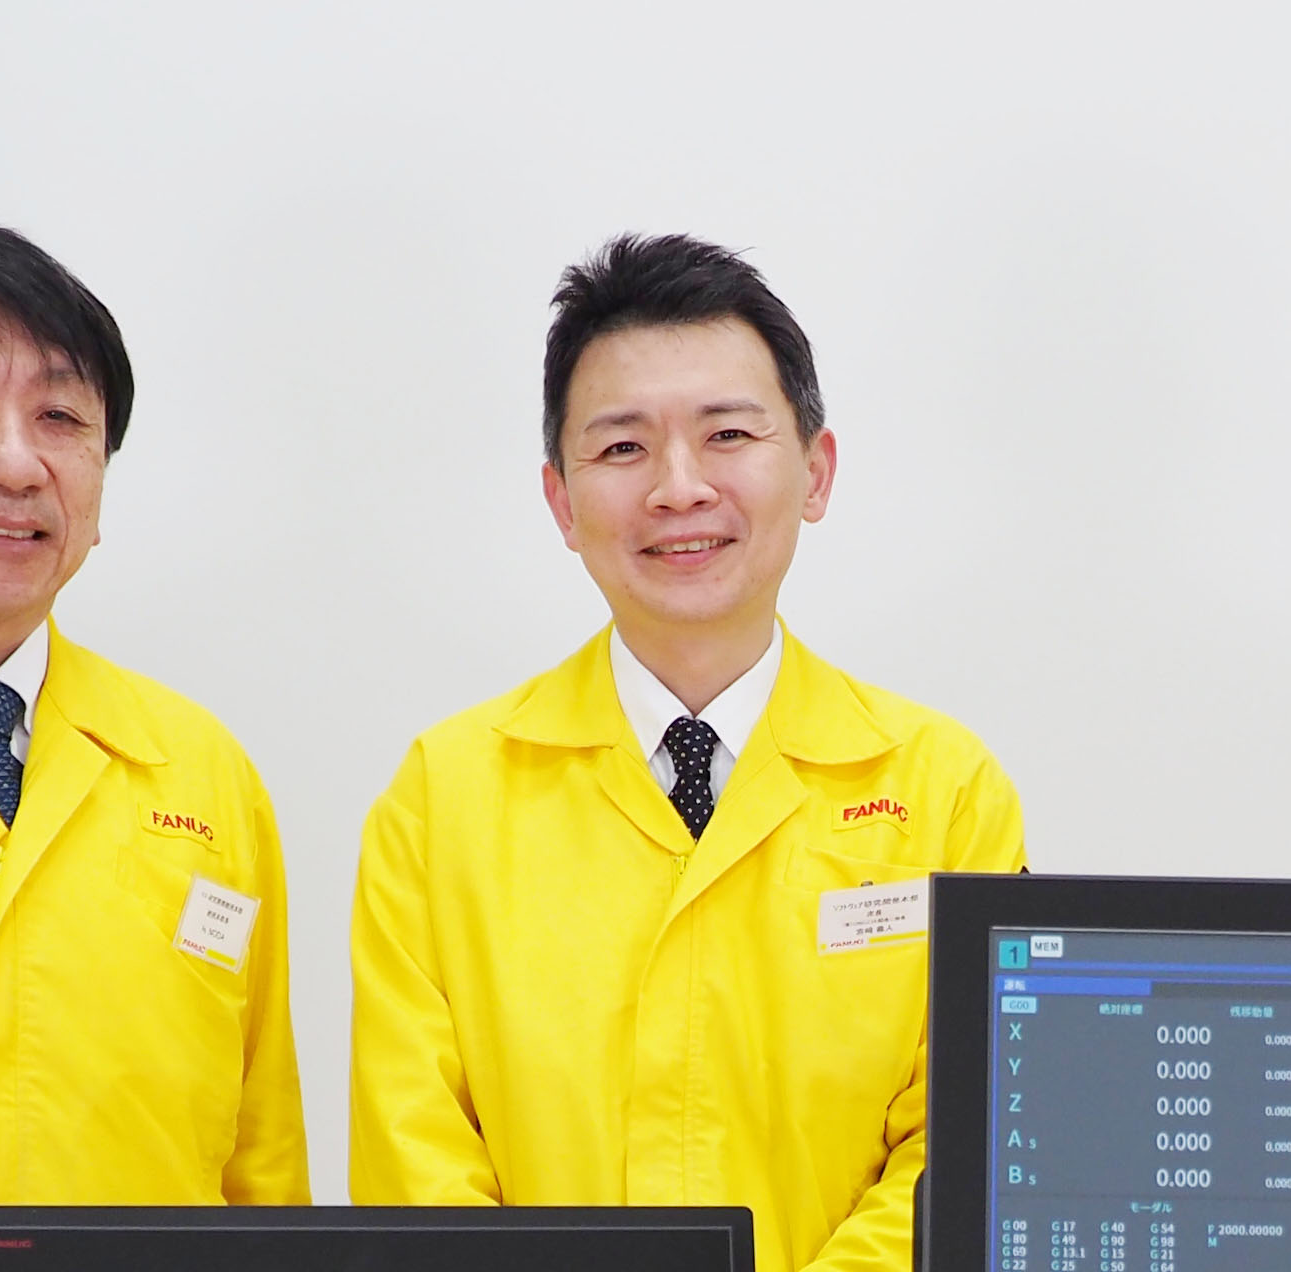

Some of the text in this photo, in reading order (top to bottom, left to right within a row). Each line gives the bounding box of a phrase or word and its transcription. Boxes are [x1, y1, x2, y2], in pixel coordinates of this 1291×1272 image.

[843, 798, 908, 822] FANUC
[152, 811, 213, 842] FANUC
[1010, 946, 1018, 963] 1
[1035, 942, 1059, 951] MEM
[1010, 1023, 1021, 1040] X
[1157, 1026, 1211, 1044] 0.000
[1009, 1058, 1021, 1075] Y
[1157, 1061, 1211, 1079] 0.000
[1009, 1094, 1021, 1112] Z
[1157, 1097, 1211, 1115] 0.000
[1008, 1130, 1021, 1147] A
[1157, 1132, 1211, 1151] 0.000
[1009, 1166, 1022, 1183] B
[1157, 1168, 1211, 1187] 0.000
[1218, 1225, 1283, 1236] 2000.00000
